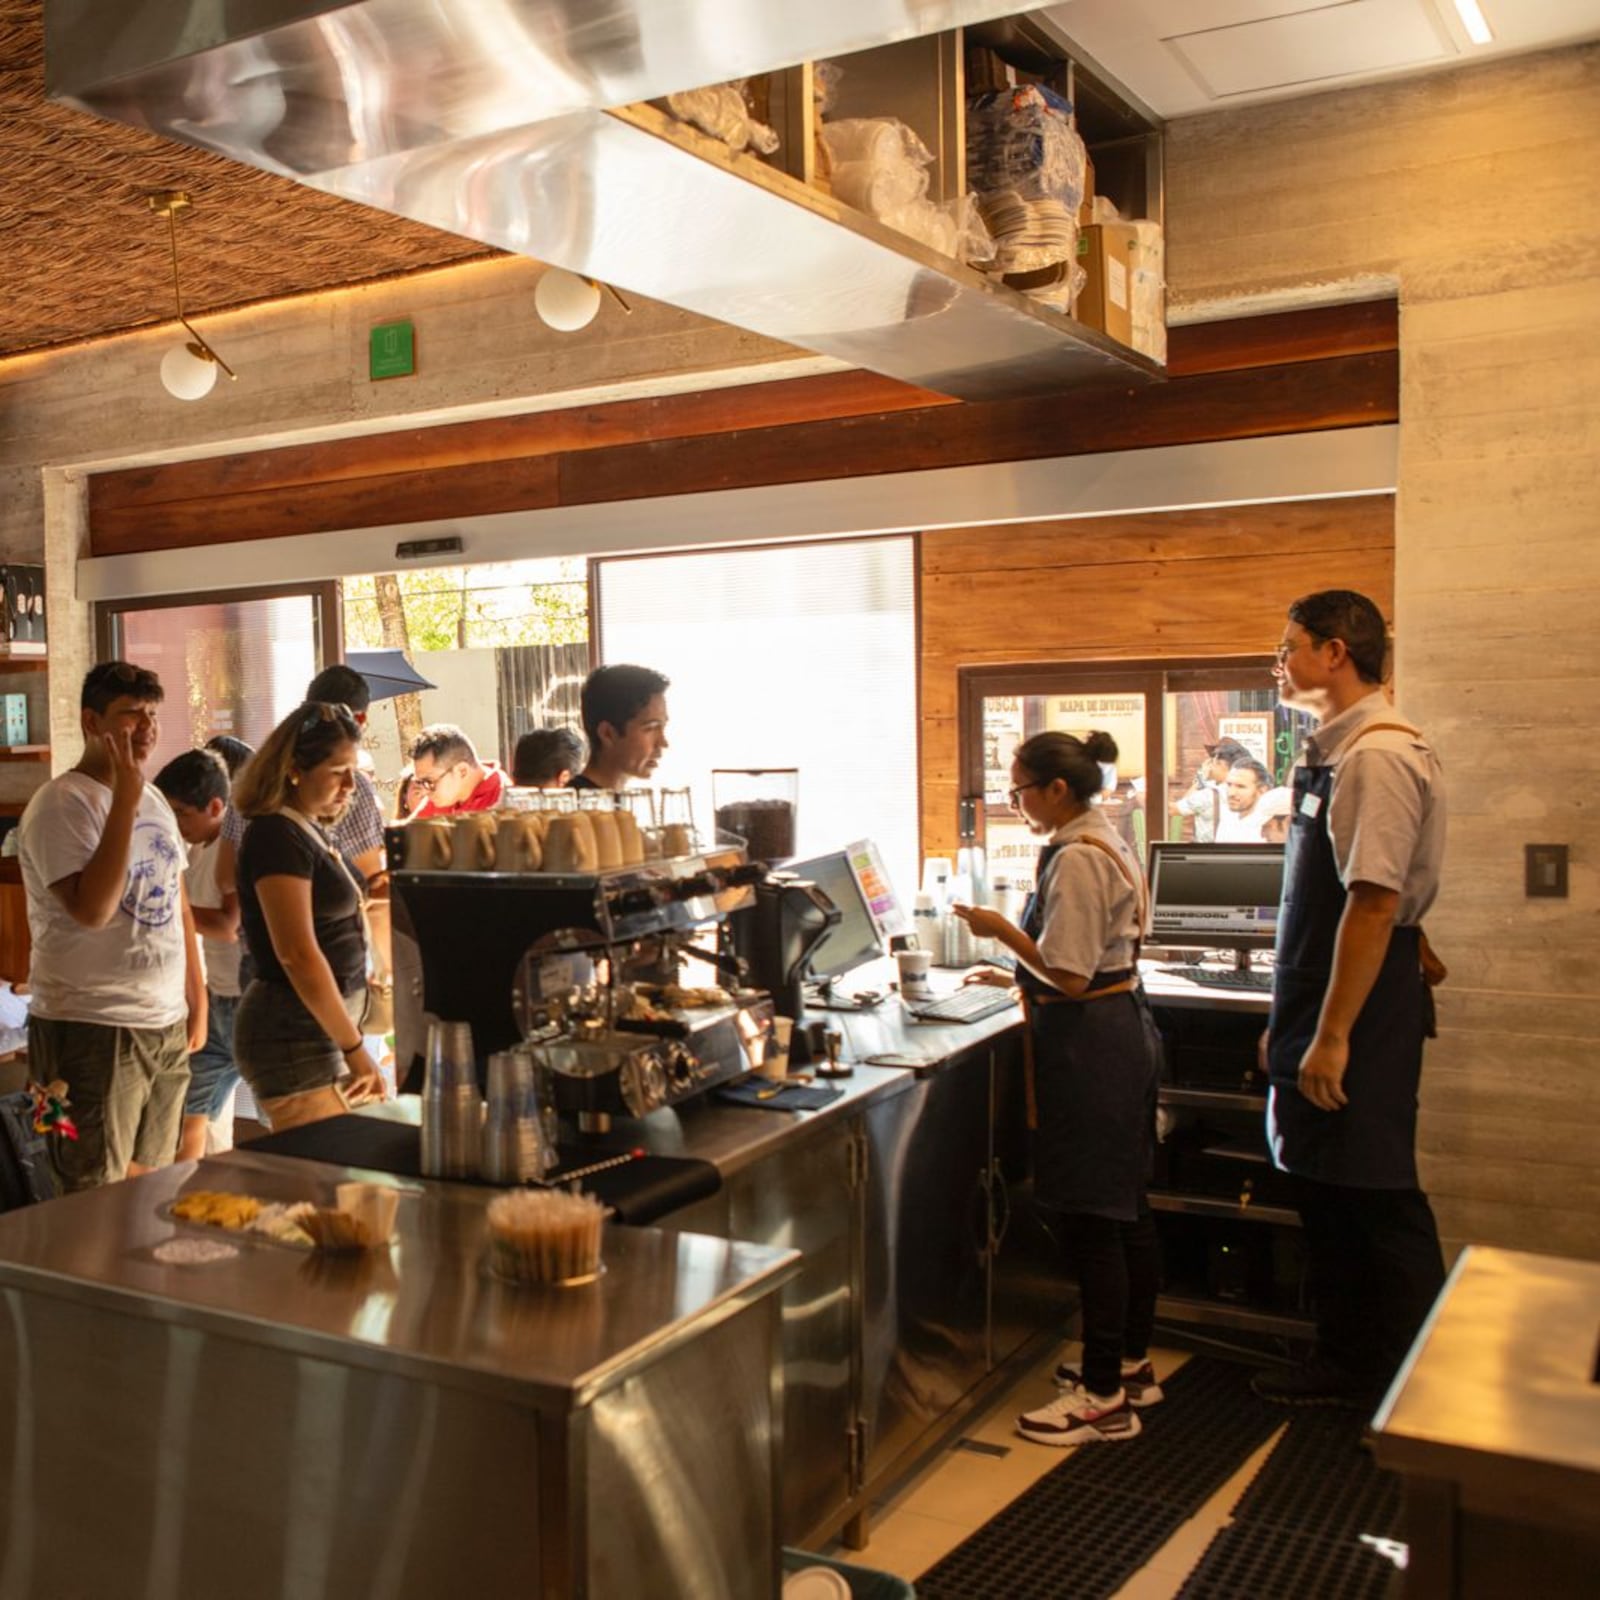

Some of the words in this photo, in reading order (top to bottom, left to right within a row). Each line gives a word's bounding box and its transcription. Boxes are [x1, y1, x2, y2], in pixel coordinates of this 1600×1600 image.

[1059, 700, 1085, 713] MAPA
[1087, 700, 1098, 712] DE
[1223, 723, 1235, 734] SE
[1237, 723, 1263, 734] BUSCA
